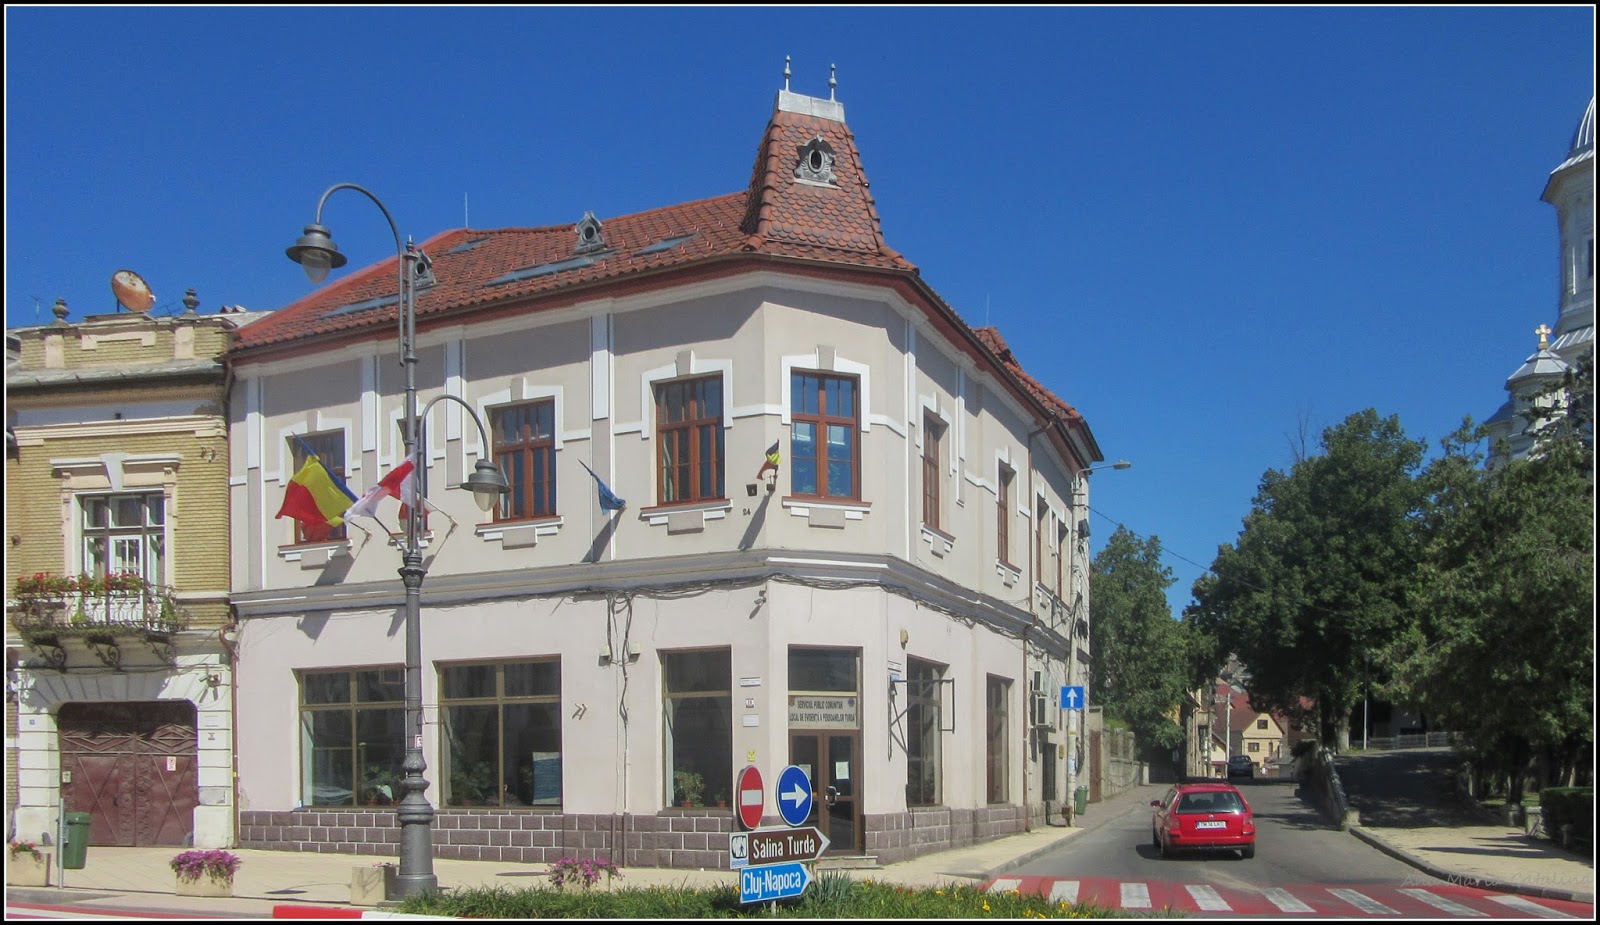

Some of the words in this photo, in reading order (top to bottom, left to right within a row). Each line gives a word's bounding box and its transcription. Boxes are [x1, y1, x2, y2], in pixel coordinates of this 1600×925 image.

[797, 700, 813, 709] SERVICIUL
[813, 700, 824, 709] PUBLIC
[789, 713, 799, 722] LOCAL
[752, 837, 784, 859] Salina
[787, 834, 815, 856] Turda
[742, 869, 801, 899] Cluj-Napoca
